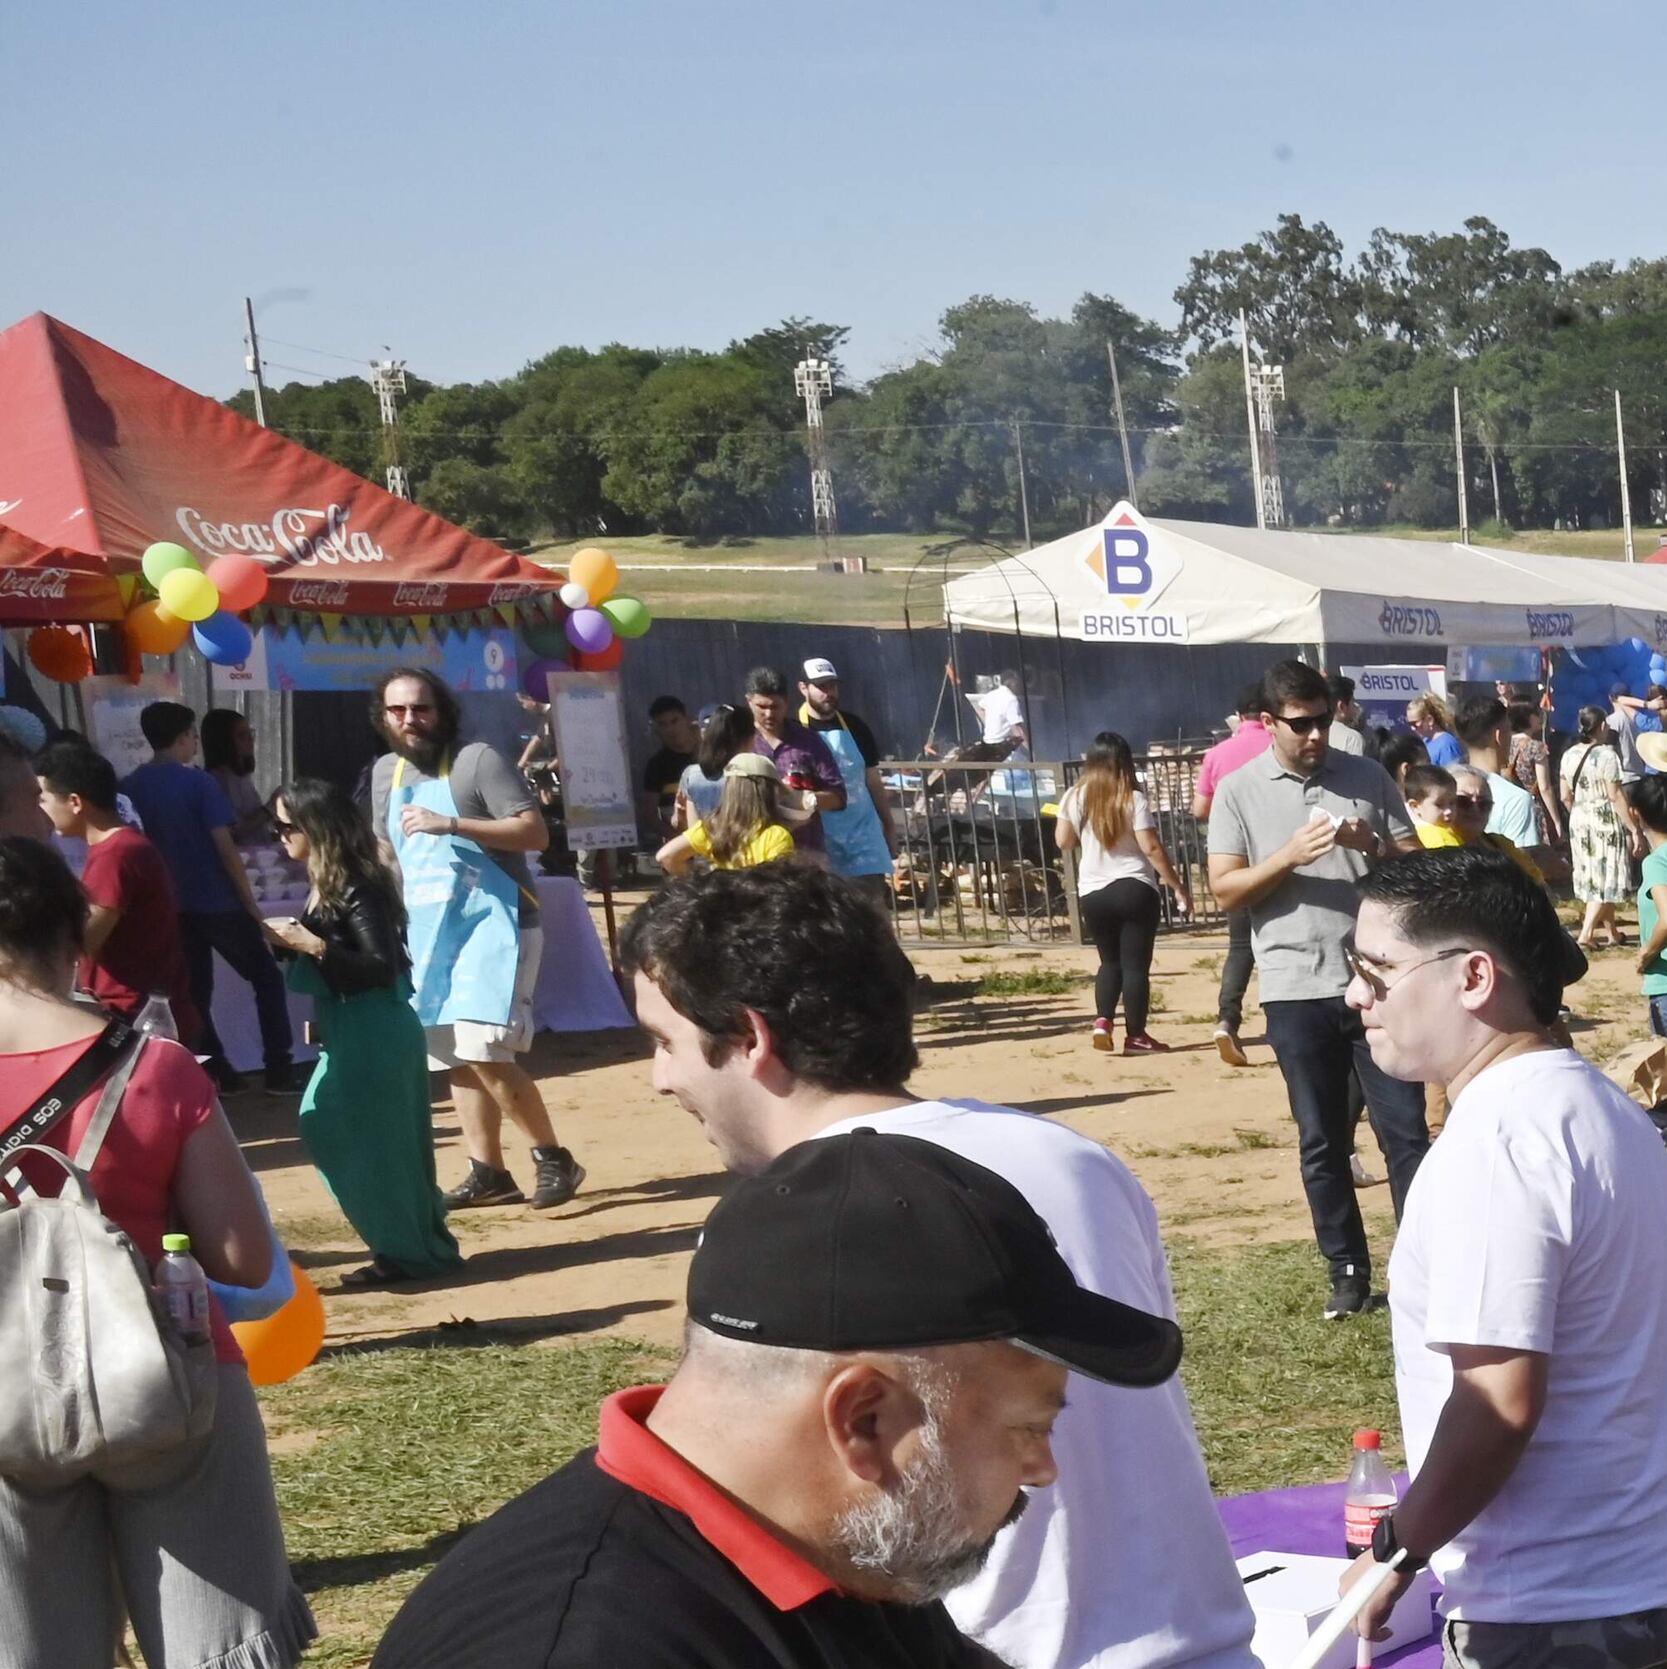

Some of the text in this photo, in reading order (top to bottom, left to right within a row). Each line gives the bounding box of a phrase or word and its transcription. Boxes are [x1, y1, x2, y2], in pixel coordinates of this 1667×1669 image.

[175, 503, 385, 567] Coca-Cola
[1104, 529, 1153, 594] B
[1084, 615, 1183, 637] BRISTOL
[1382, 604, 1444, 636] BRISTOL
[1361, 673, 1420, 692] BRISTOL
[33, 1097, 62, 1127] EOS
